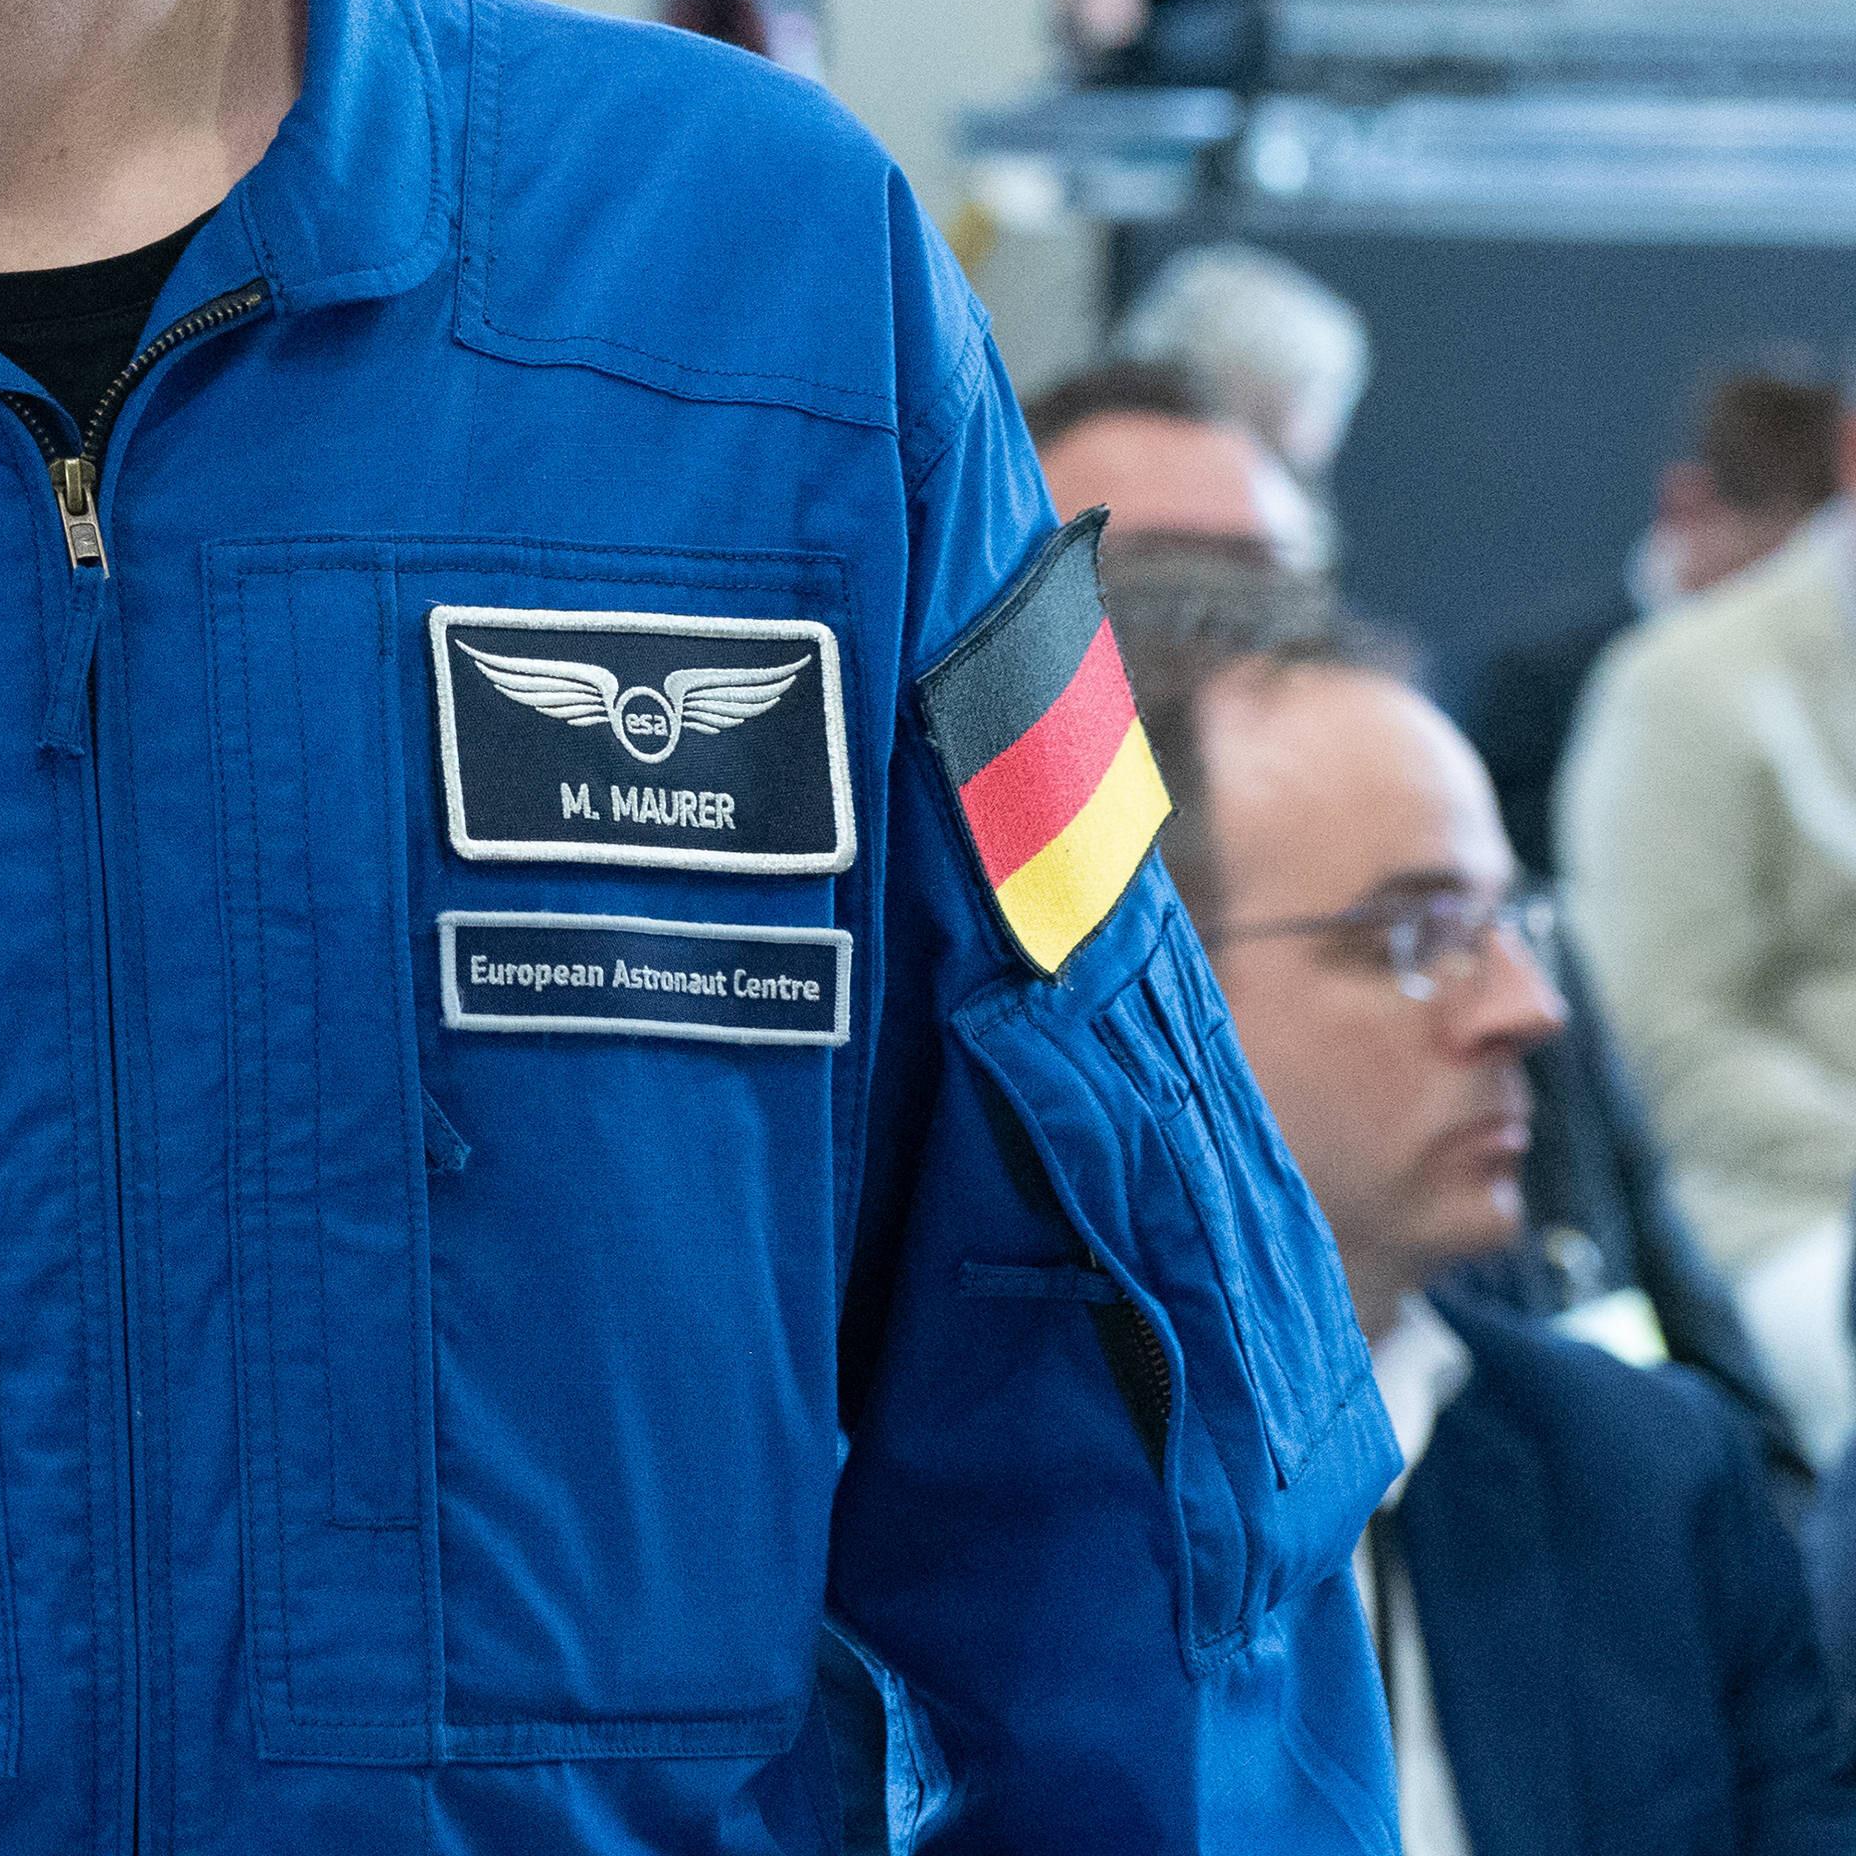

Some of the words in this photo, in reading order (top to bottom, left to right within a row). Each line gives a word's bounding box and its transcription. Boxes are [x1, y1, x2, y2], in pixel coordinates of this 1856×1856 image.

[625, 713, 668, 737] esa
[560, 782, 600, 820] M.
[610, 785, 736, 830] MAURER
[469, 954, 605, 992] European
[611, 959, 728, 996] Astronaut
[733, 968, 821, 1002] Centre
